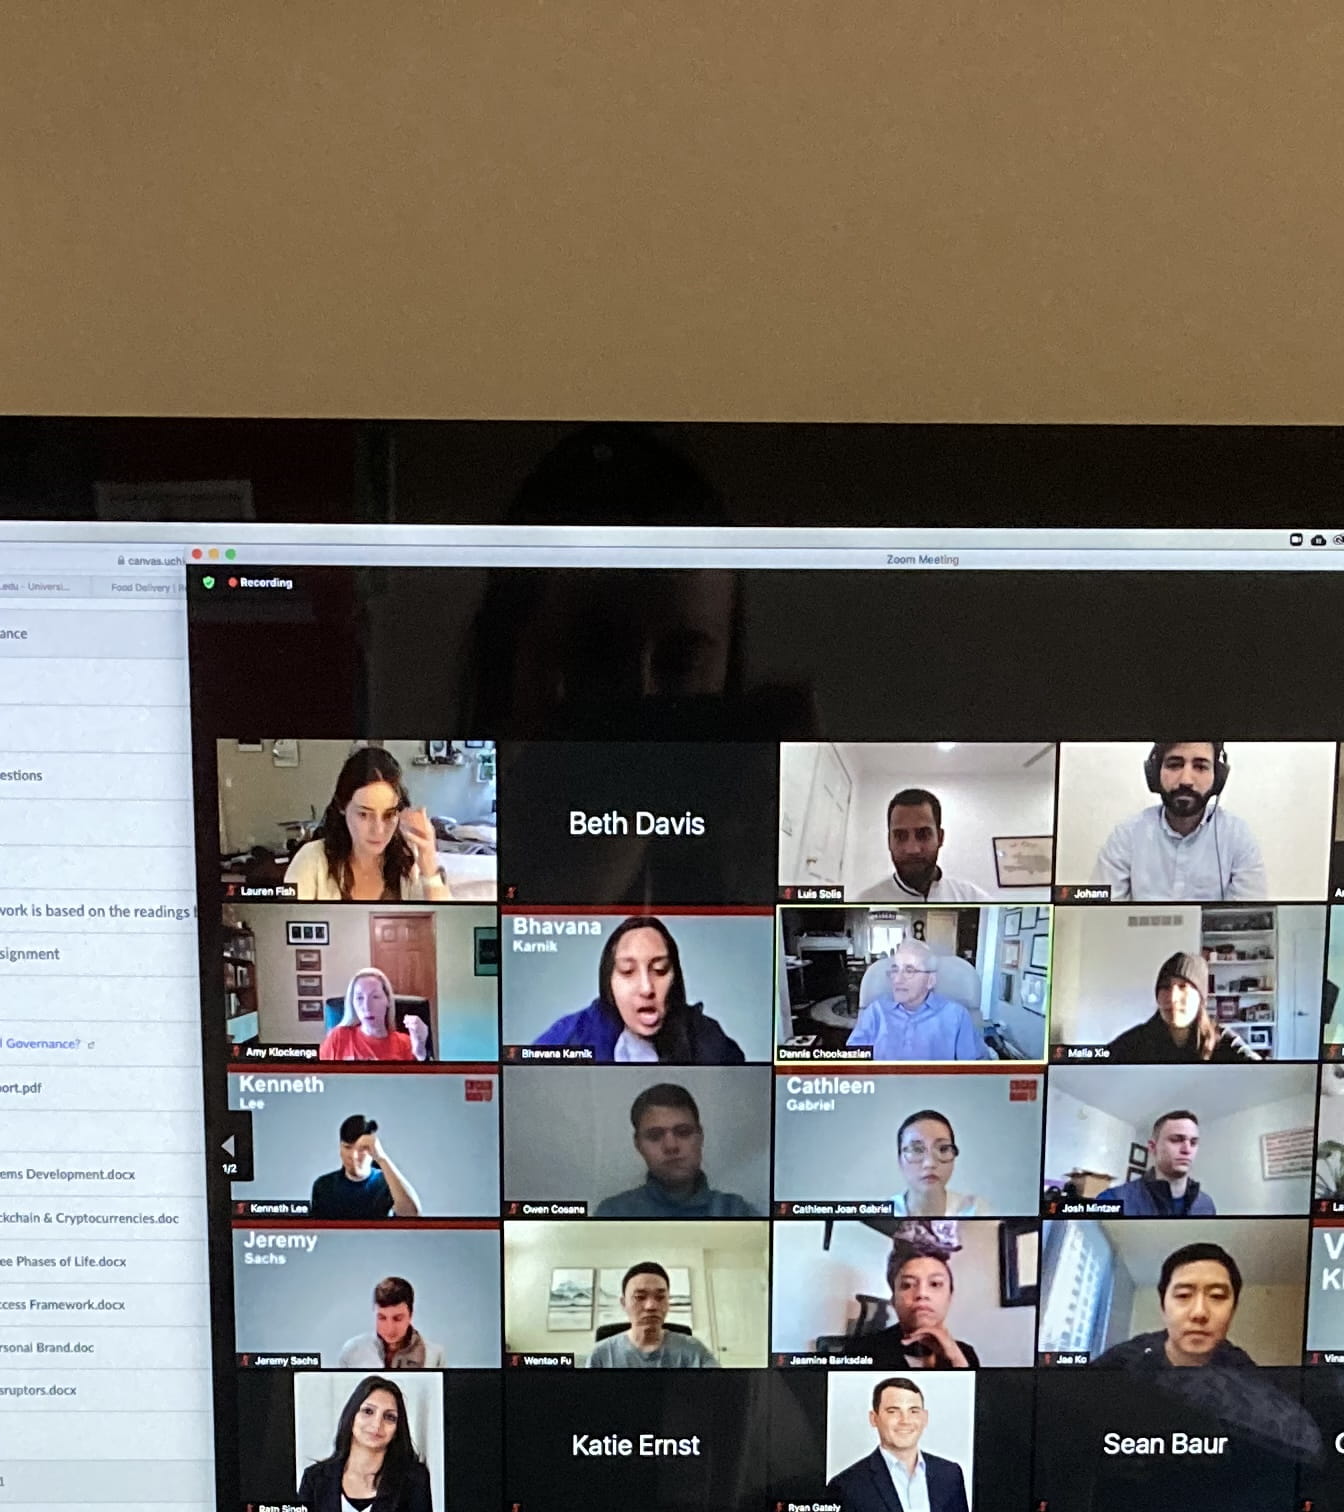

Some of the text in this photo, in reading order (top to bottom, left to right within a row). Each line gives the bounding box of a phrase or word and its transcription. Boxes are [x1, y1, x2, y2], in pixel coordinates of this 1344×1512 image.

[887, 555, 959, 566] Zoom Meeting
[240, 578, 292, 589] Recording
[570, 811, 704, 835] Beth Davis
[241, 887, 296, 896] Lauren Fish
[32, 904, 42, 916] is
[46, 904, 84, 916] based
[88, 908, 105, 917] on
[109, 904, 130, 917] the
[134, 905, 190, 920] readings
[514, 917, 601, 934] Bhavana
[514, 940, 557, 952] Karnik
[6, 1038, 80, 1049] Governance?
[240, 1075, 324, 1092] Kenneth
[787, 1076, 874, 1094] Cathleen
[240, 1098, 264, 1109] Lee
[787, 1099, 834, 1110] Gabriel
[26, 1169, 135, 1182] Development.docx
[244, 1231, 317, 1252] Jeremy
[245, 1253, 286, 1264] Sachs
[255, 1356, 318, 1366] Jeremy Sachs
[573, 1434, 700, 1455] Katie Ernst
[1104, 1433, 1228, 1454] Sean Baur
[812, 1504, 841, 1512] Gately
